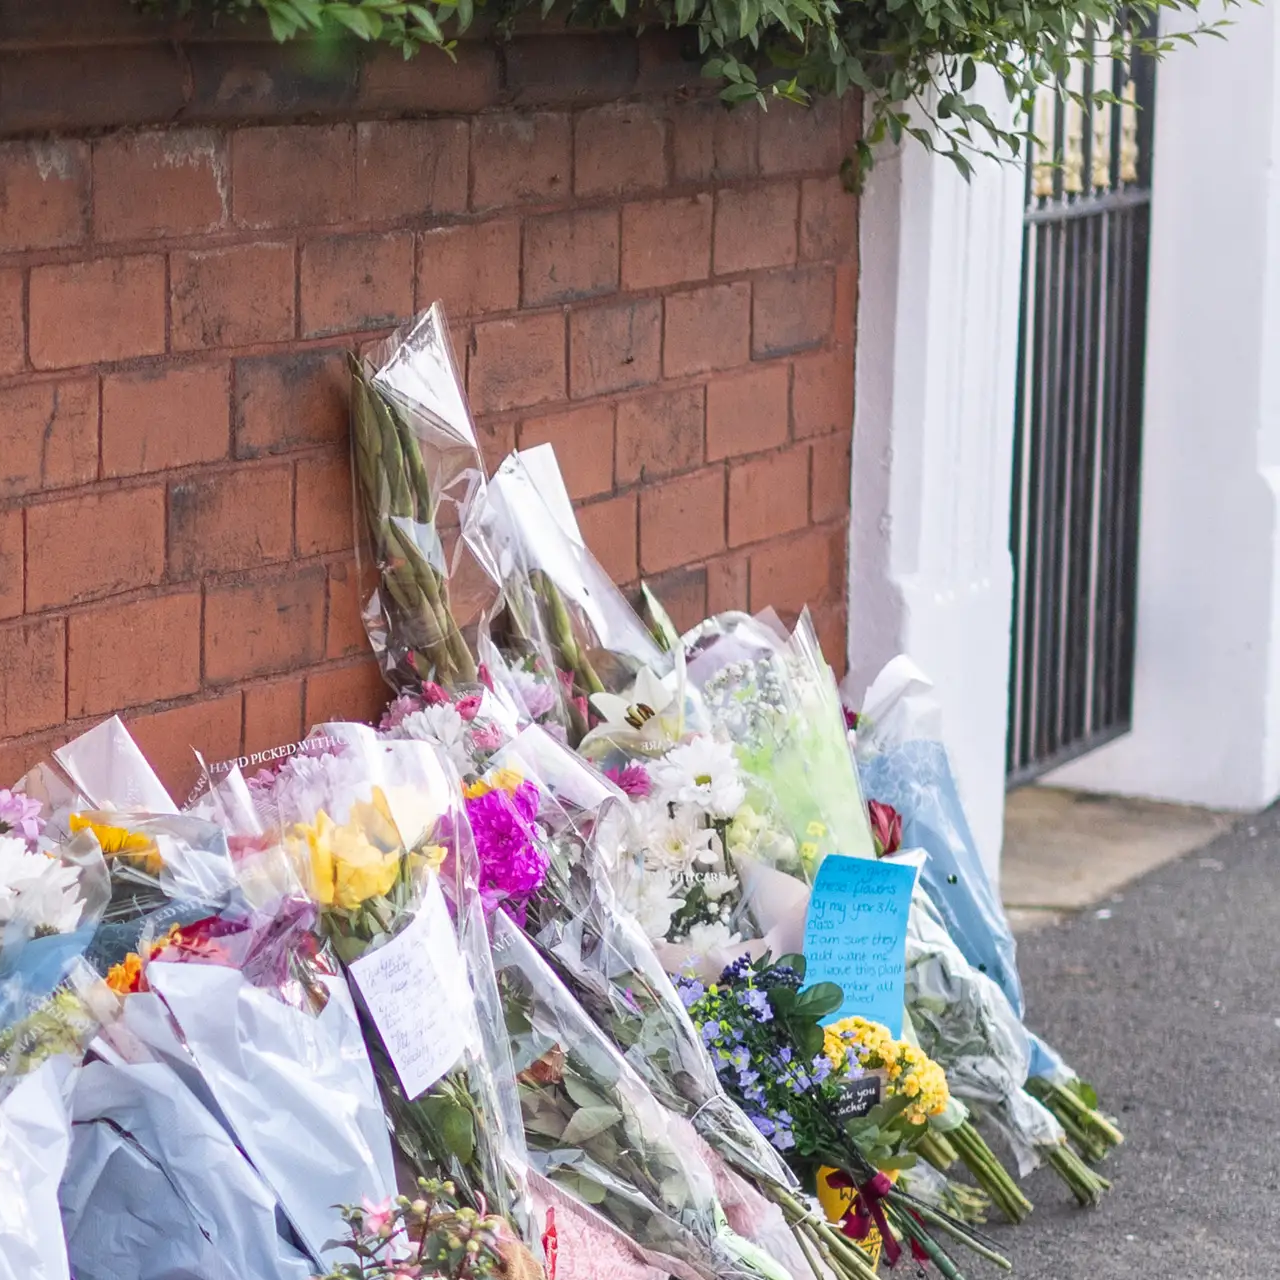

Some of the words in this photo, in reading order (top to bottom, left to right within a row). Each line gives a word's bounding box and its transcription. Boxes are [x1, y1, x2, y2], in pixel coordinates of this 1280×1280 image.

[210, 756, 249, 774] HAND
[251, 743, 297, 766] PICKED
[297, 734, 336, 752] WITH
[814, 879, 848, 893] these
[852, 880, 897, 898] flowers
[812, 898, 826, 920] by
[830, 902, 846, 925] my
[876, 898, 898, 915] 3/4
[807, 934, 817, 945] I
[819, 935, 840, 945] am
[844, 935, 869, 946] sure
[871, 931, 898, 954] they
[855, 960, 877, 976] this
[877, 962, 903, 978] plant
[856, 1087, 876, 1103] you
